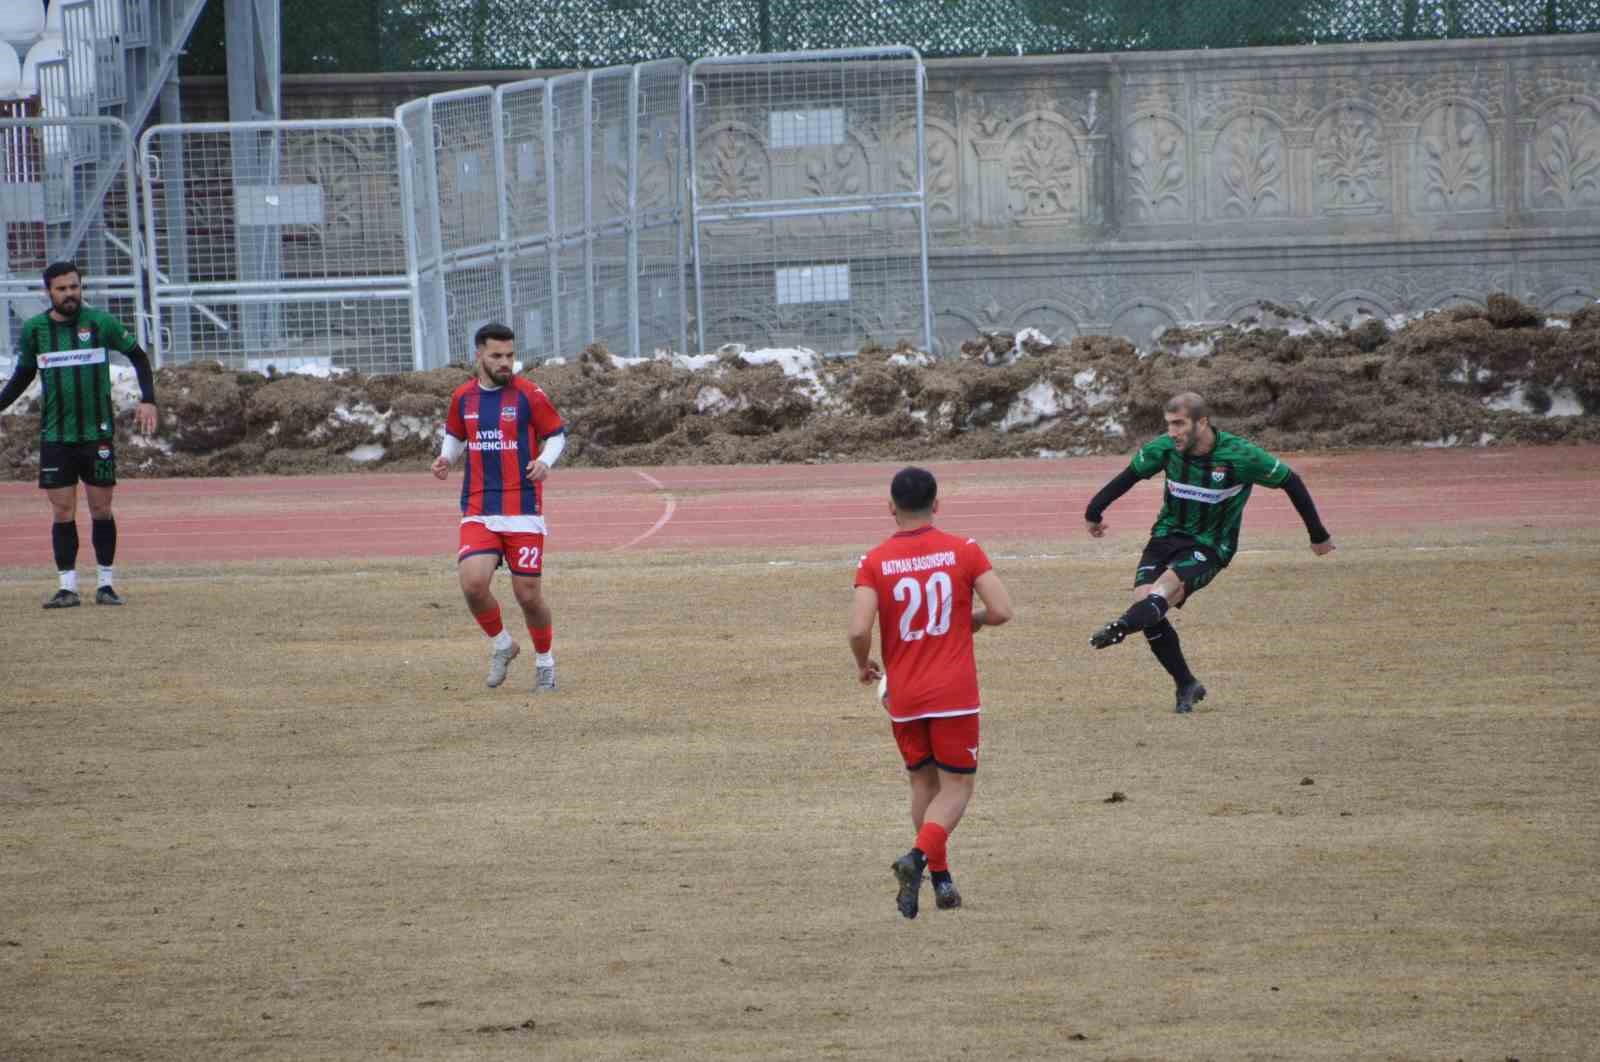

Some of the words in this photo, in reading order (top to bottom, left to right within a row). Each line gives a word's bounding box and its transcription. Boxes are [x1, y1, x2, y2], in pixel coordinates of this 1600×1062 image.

[518, 546, 538, 569] 22
[881, 559, 912, 576] BATMAN
[892, 571, 953, 642] 20
